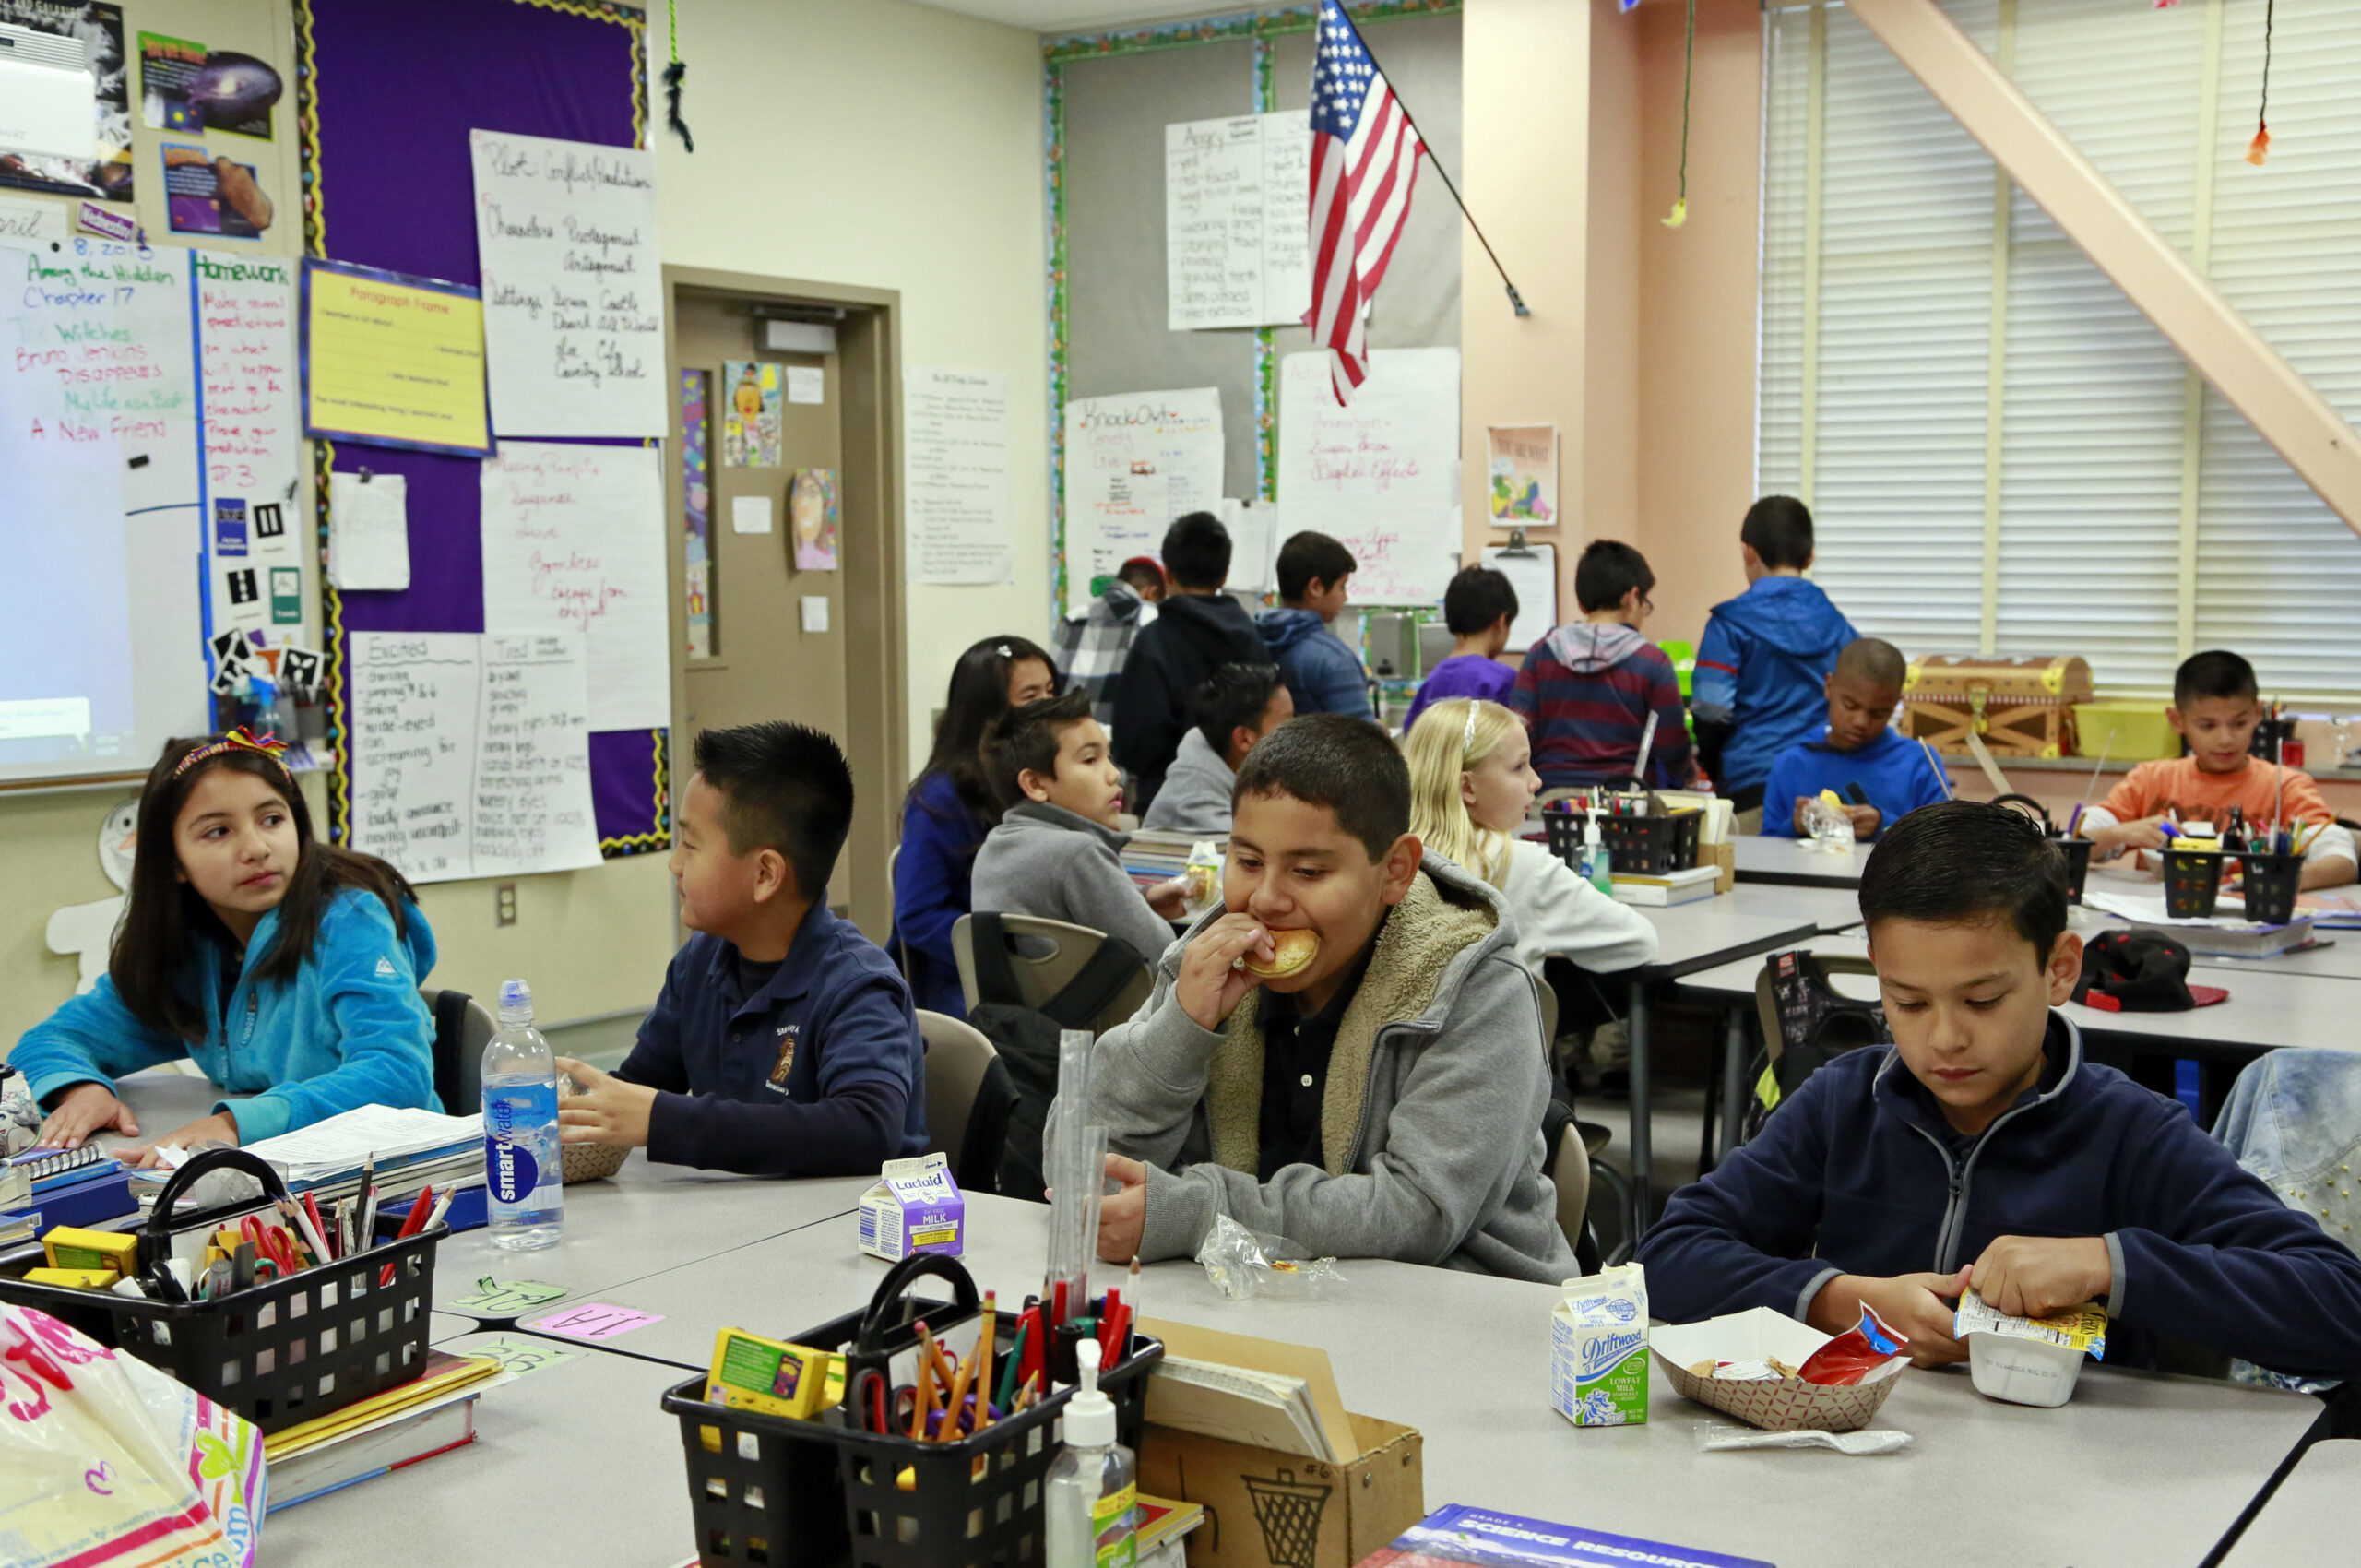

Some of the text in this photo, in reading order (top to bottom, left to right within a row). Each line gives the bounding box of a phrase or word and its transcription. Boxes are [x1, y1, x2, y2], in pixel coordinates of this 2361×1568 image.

[114, 263, 174, 288] Hidden
[195, 255, 290, 287] Homework
[23, 287, 135, 310] Chapter 17
[55, 321, 132, 343] Witches
[30, 418, 45, 442] A
[111, 417, 167, 440] Friend
[369, 636, 428, 661] Excited
[896, 1173, 943, 1190] Lactaid
[922, 1213, 947, 1225] MILK
[1572, 1295, 1608, 1314] Driftwood
[1583, 1329, 1642, 1367] Driftwood
[1609, 1375, 1641, 1385] LOWFAT
[1616, 1384, 1635, 1392] MILK
[1304, 1463, 1330, 1479] #6
[1469, 1514, 1511, 1526] GRADE
[1458, 1518, 1570, 1547] SCIENCE
